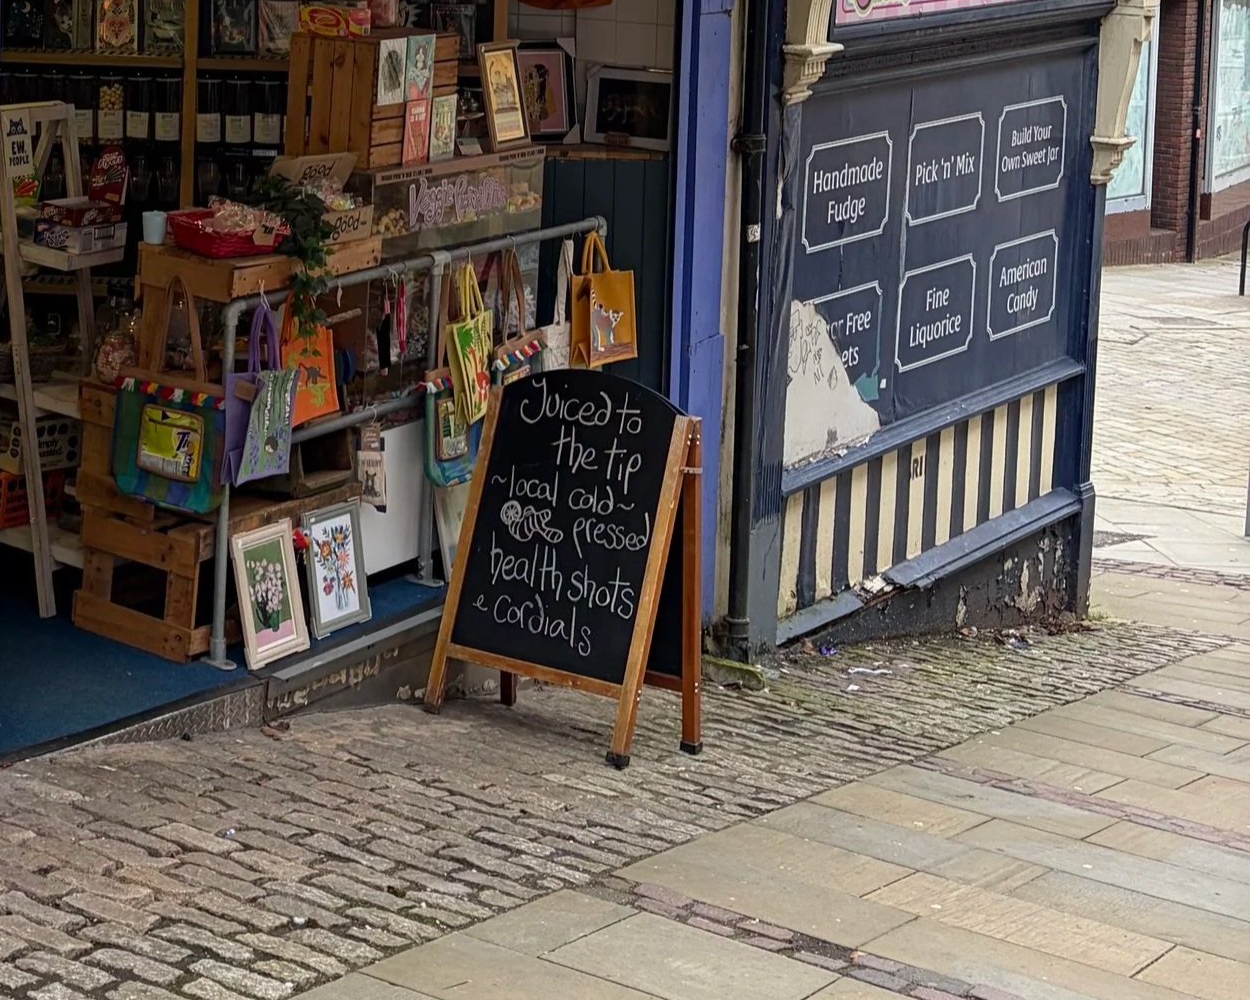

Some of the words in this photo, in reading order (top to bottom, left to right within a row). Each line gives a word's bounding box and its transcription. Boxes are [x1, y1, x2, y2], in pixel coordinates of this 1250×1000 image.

[1011, 126, 1033, 146] Build
[1033, 124, 1053, 142] Your
[9, 155, 30, 167] PEOPLE
[813, 156, 884, 194] Handmade
[915, 161, 938, 187] Pick
[956, 153, 976, 176] Mix
[1001, 154, 1021, 173] Own
[1021, 149, 1046, 169] Sweet
[1046, 145, 1059, 167] Jar
[332, 210, 362, 241] good
[827, 195, 866, 225] Fudge
[999, 255, 1048, 288] American
[926, 286, 950, 311] Fine
[1007, 287, 1039, 315] Candy
[845, 309, 872, 337] Free
[909, 313, 962, 350] Liquorice
[520, 377, 611, 426] Juiced
[615, 391, 642, 434] to
[551, 424, 598, 474] the
[604, 438, 643, 495] tip
[572, 512, 651, 559] pressed
[490, 531, 563, 602] health
[567, 564, 635, 620] shots
